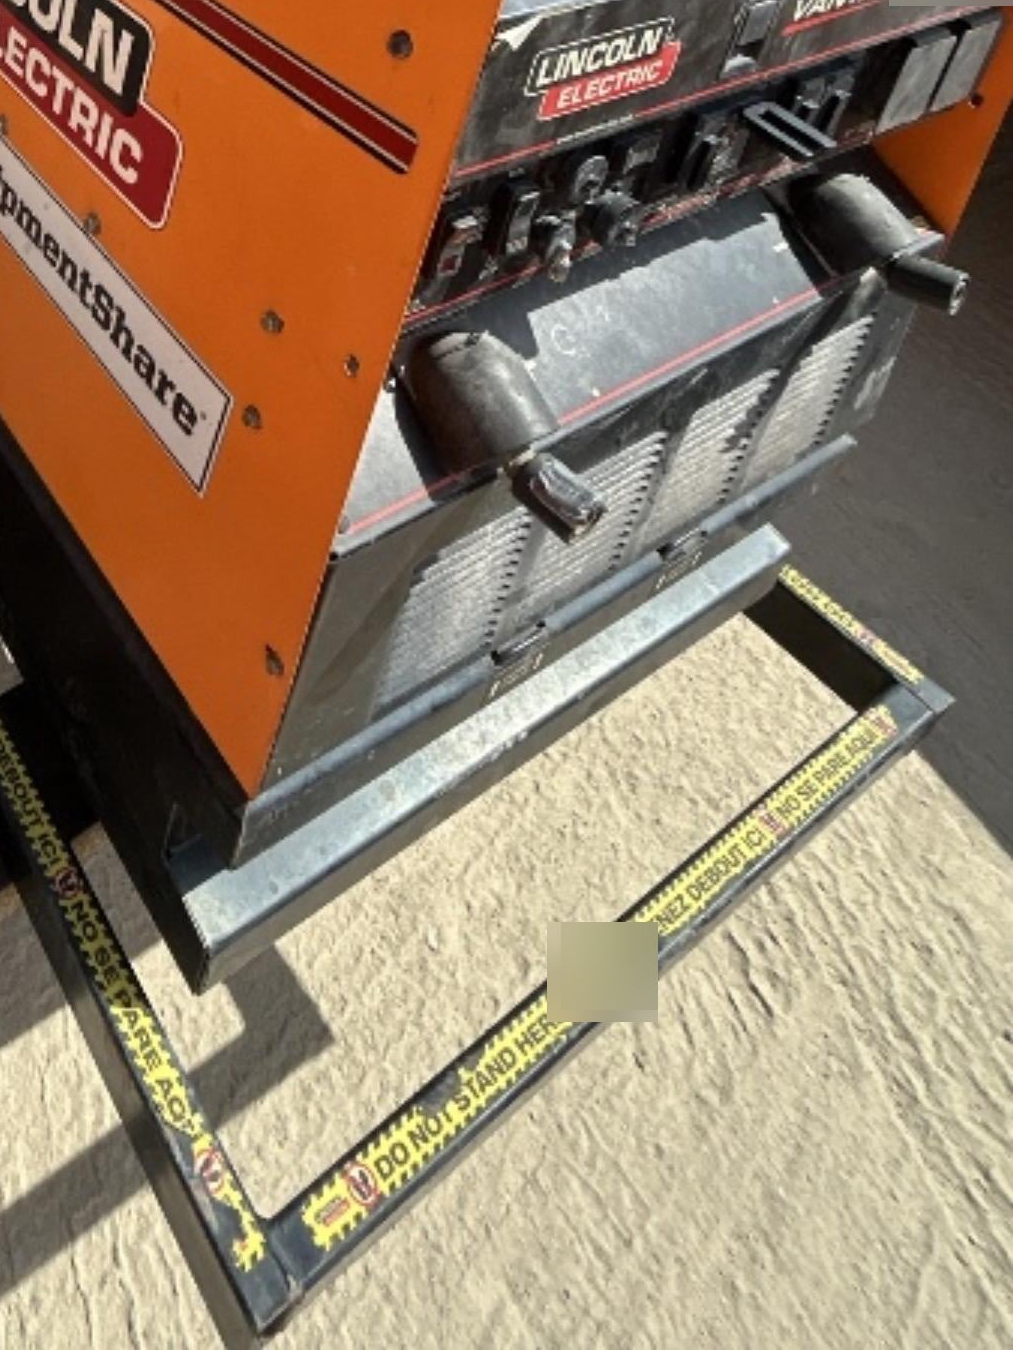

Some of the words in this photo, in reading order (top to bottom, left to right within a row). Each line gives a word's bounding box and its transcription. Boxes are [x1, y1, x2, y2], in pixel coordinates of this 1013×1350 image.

[536, 27, 663, 87] LINCOLN
[557, 59, 663, 109] ELECTRIC
[688, 842, 748, 901] DEBOUT
[775, 794, 802, 820] NO
[71, 900, 100, 942] NO
[94, 947, 120, 984] SE
[115, 987, 163, 1072] PARE
[374, 1141, 411, 1182] DO
[454, 1048, 517, 1111] STAND
